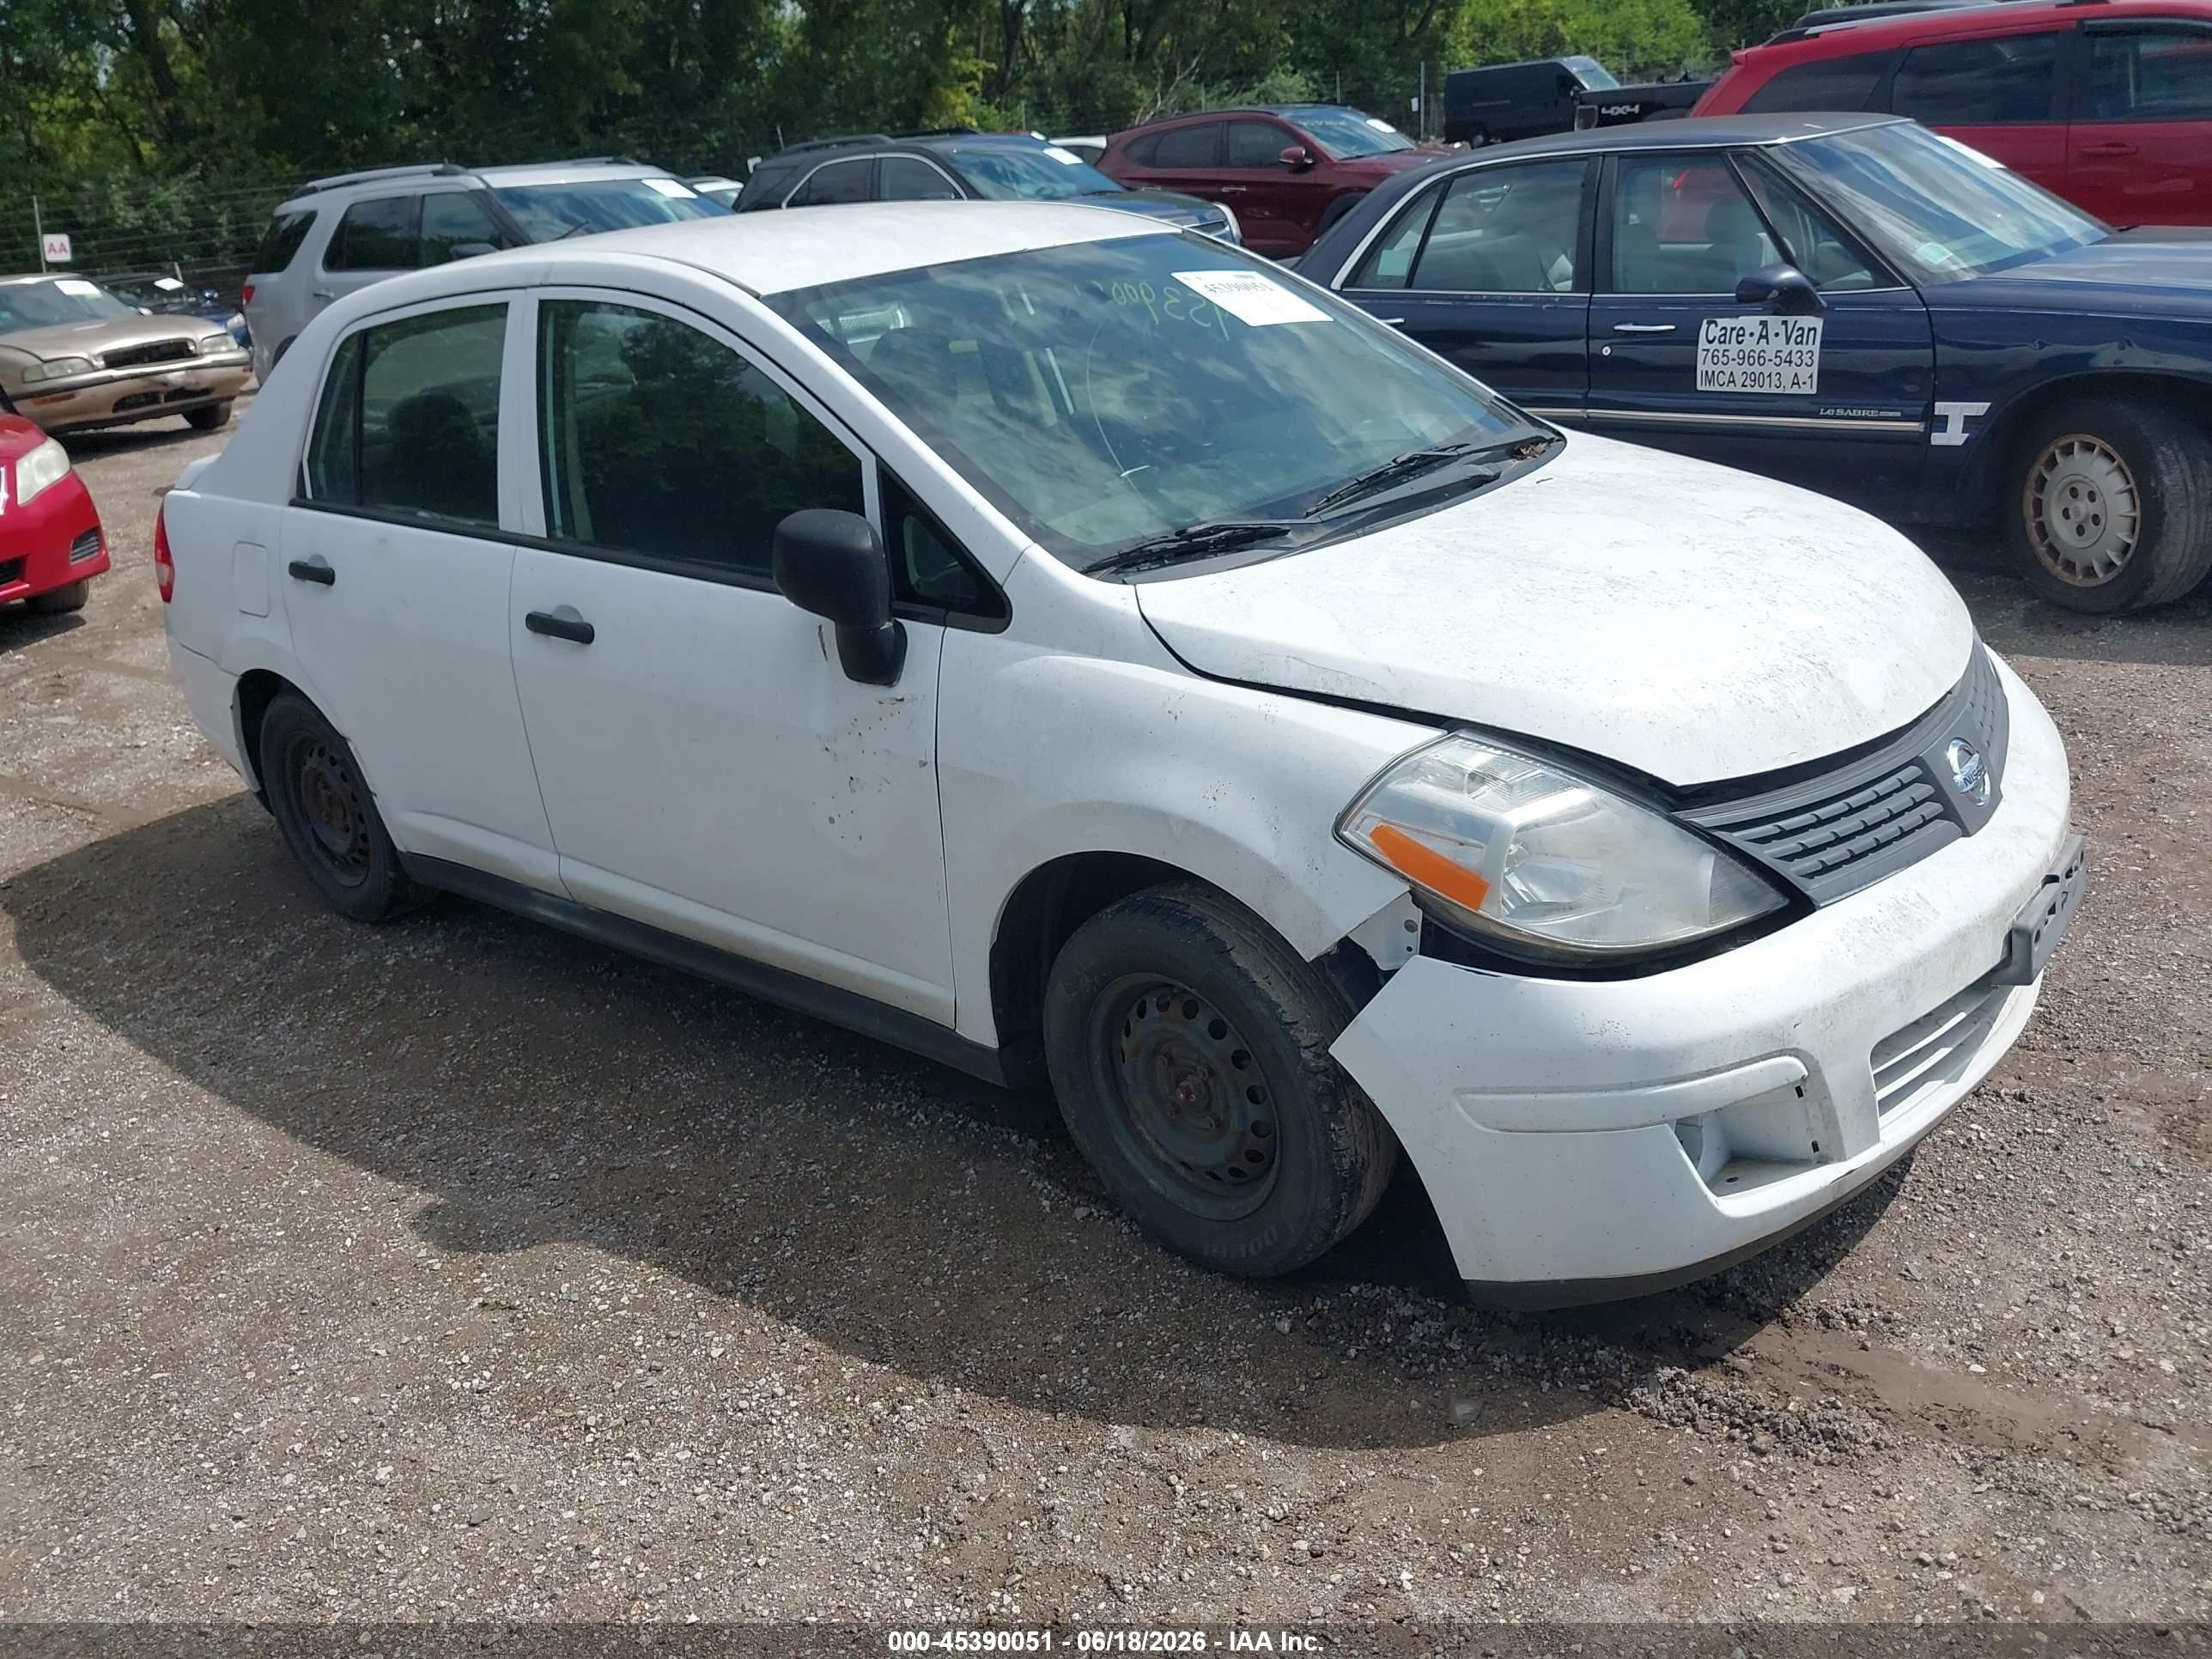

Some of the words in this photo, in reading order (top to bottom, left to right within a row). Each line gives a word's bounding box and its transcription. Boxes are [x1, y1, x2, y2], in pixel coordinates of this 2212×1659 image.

[48, 241, 68, 254] AA
[1702, 349, 1814, 367] 765-966-5433
[1700, 370, 1736, 386] IMCA
[1741, 371, 1786, 392] 29013,
[1790, 372, 1814, 390] A-1
